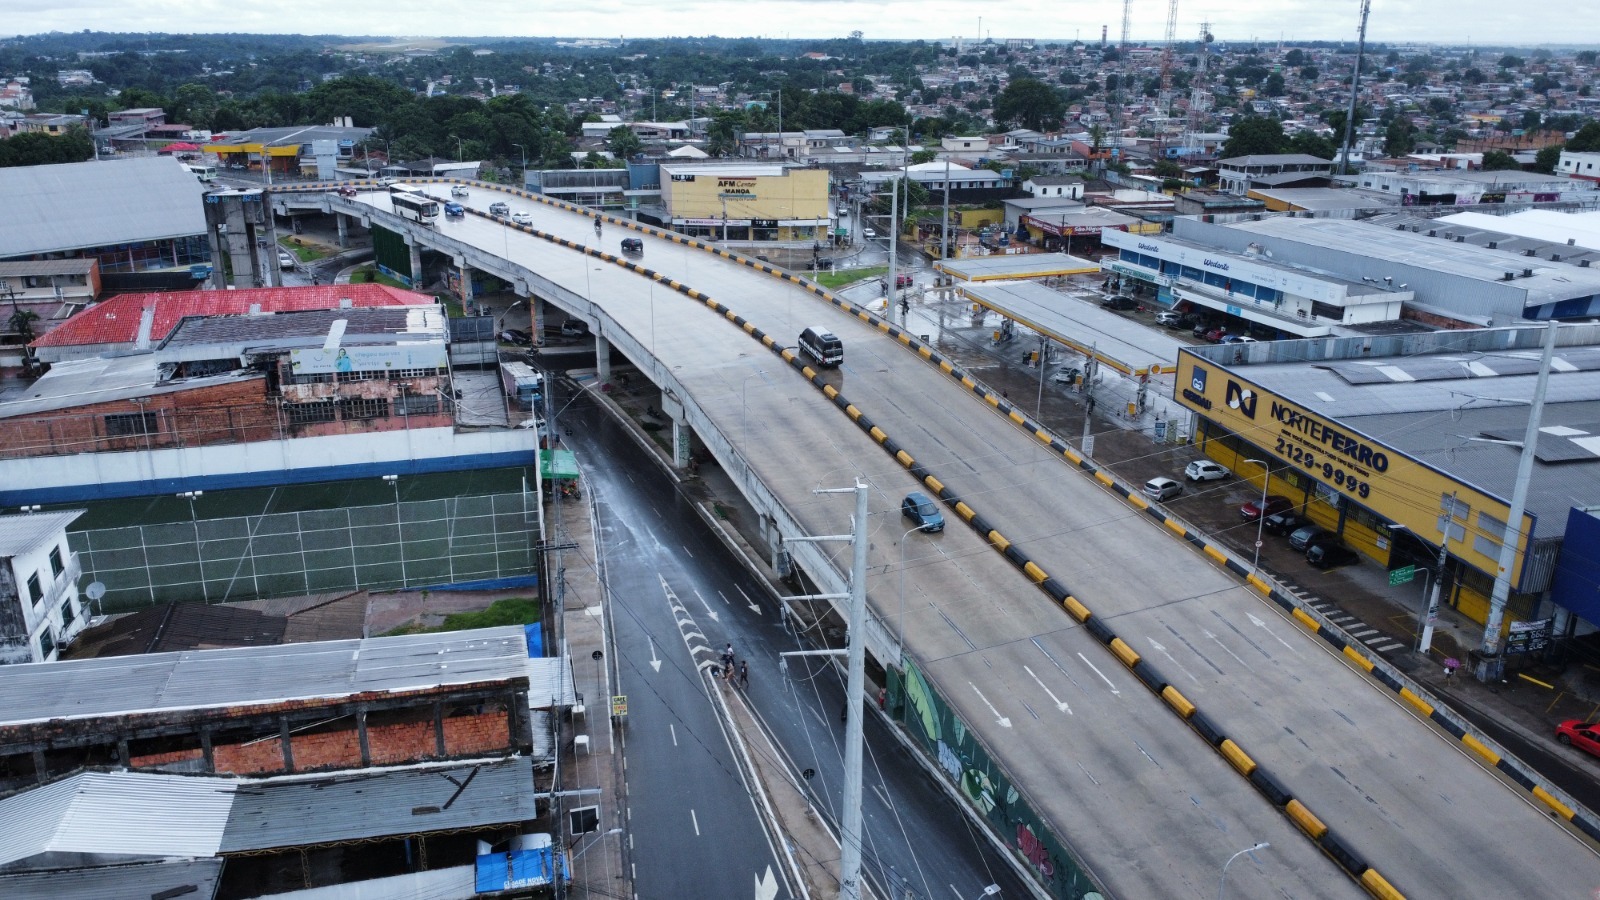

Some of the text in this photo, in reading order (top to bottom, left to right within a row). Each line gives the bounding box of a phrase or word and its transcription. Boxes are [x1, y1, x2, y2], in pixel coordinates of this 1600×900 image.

[736, 180, 757, 188] Center
[1270, 400, 1388, 473] NORTEFERRO
[1274, 436, 1370, 499] 2129-9999
